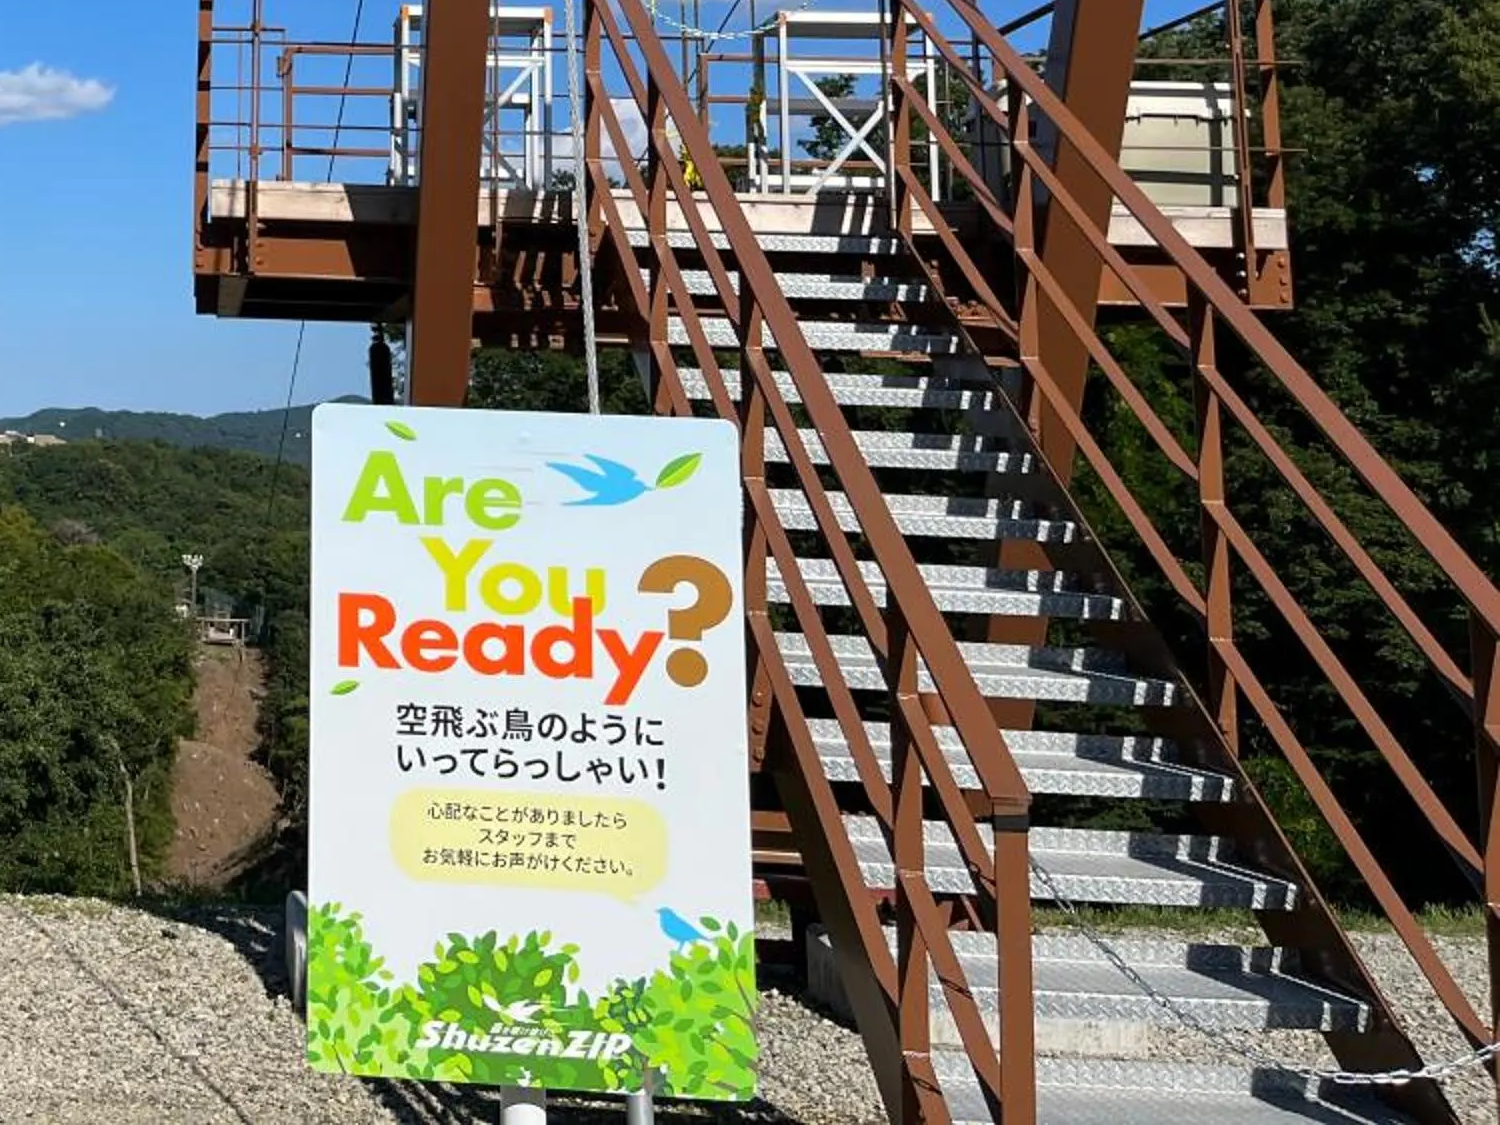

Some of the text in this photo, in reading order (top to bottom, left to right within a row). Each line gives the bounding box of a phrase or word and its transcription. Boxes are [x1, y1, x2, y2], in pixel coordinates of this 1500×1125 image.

[341, 451, 522, 530] Are
[419, 537, 607, 617] You
[396, 702, 665, 746] 空飛ぶ鳥のように
[426, 801, 628, 830] 心配なことがありましたら
[478, 827, 577, 849] スタッフまで
[422, 848, 634, 876] お気軽にお声がけください。
